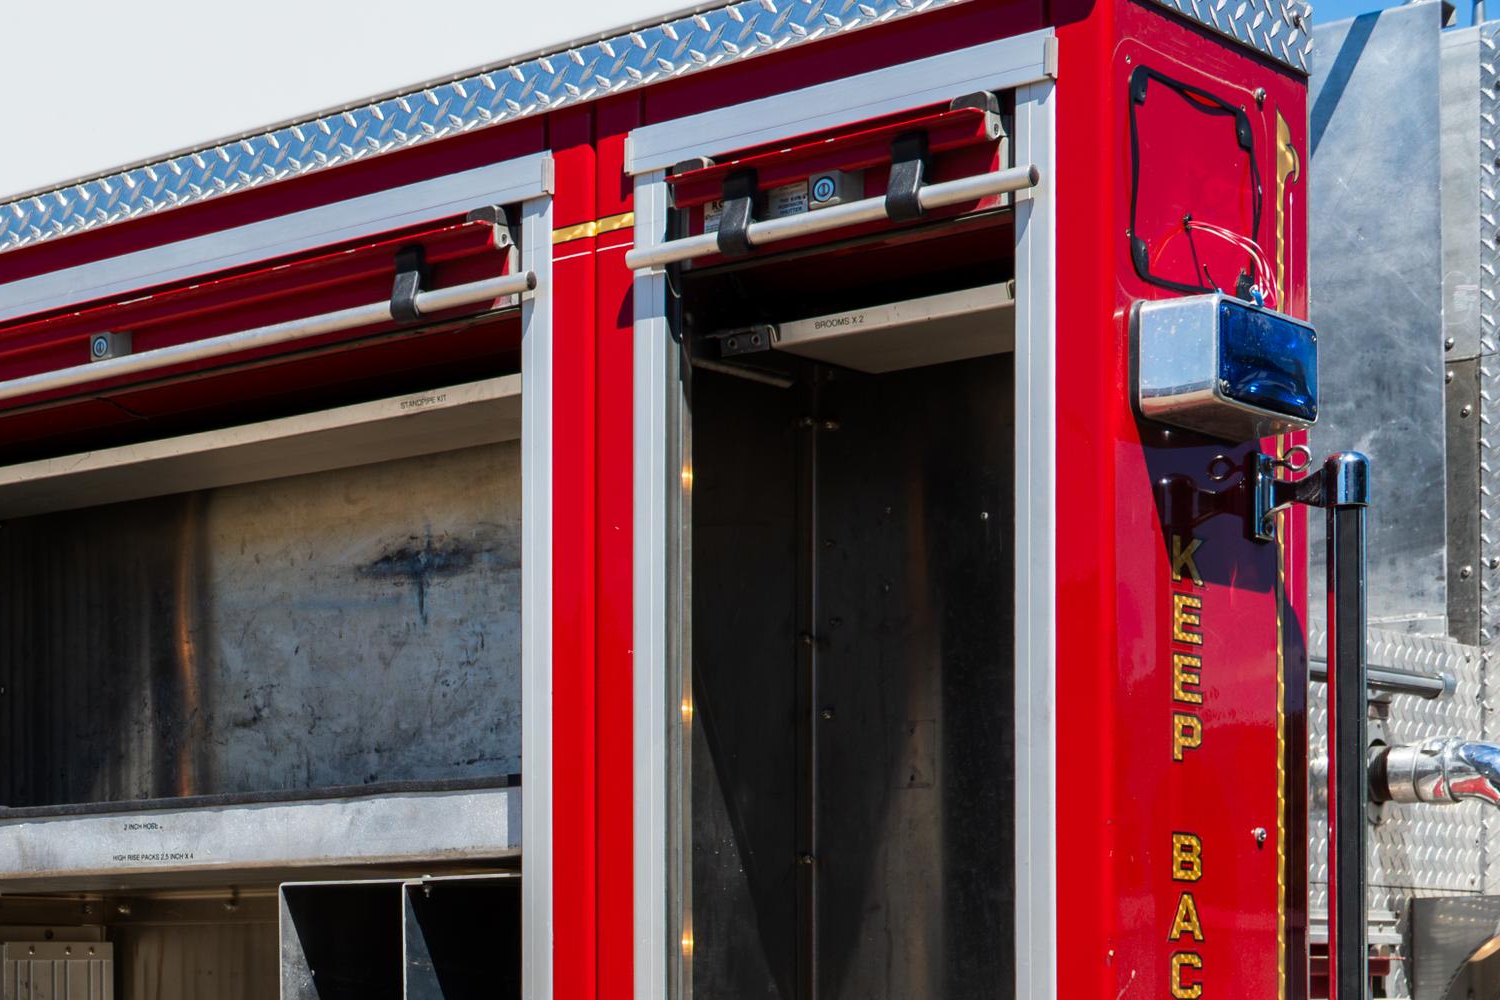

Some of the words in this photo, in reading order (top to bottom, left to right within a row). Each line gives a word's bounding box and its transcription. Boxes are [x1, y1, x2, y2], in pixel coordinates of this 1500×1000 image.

[814, 316, 850, 330] BROOMS
[859, 314, 864, 323] 2
[400, 396, 436, 409] STANDPIPE
[437, 394, 447, 402] KIT
[1171, 534, 1205, 762] KEEP
[124, 823, 128, 831] 2
[143, 822, 159, 830] HOSE
[127, 853, 140, 861] RISE
[141, 853, 160, 861] PACKS
[160, 853, 169, 861] 2.5
